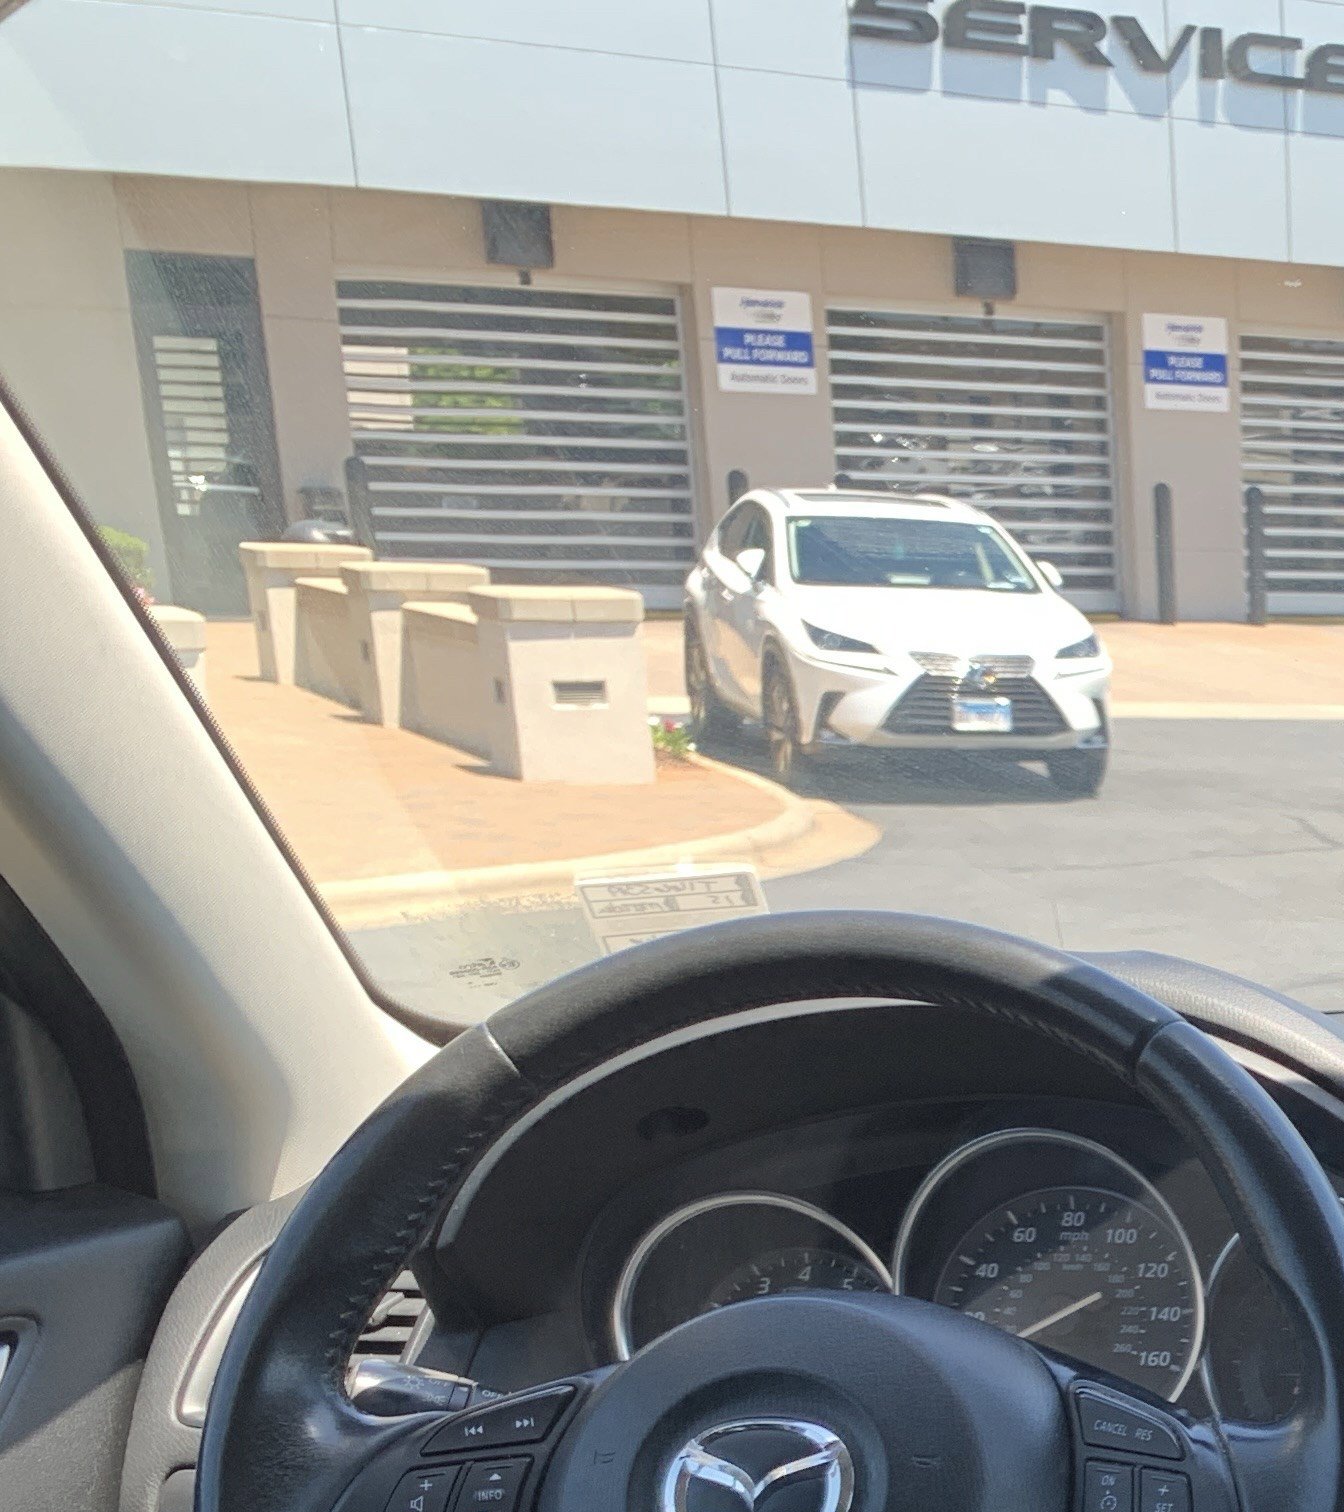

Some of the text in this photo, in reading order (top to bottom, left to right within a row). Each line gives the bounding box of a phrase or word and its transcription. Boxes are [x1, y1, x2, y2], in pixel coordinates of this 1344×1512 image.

[743, 333, 786, 347] PLEASE
[722, 347, 809, 362] PULL FORWARD
[1167, 356, 1204, 369] PLEASE
[1149, 368, 1225, 383] PULL FORWARD
[1061, 1211, 1085, 1227] 80
[1012, 1227, 1036, 1243] 60
[1059, 1231, 1090, 1242] mph
[1105, 1229, 1137, 1244] 100
[798, 1266, 812, 1282] 4
[975, 1263, 998, 1278] 40
[1136, 1262, 1168, 1278] 120
[757, 1277, 771, 1294] 3
[843, 1278, 854, 1291] 5
[1150, 1306, 1180, 1322] 140
[1138, 1350, 1170, 1367] 160
[1094, 1420, 1153, 1441] CANCEL RES
[1101, 1475, 1116, 1486] ON
[477, 1489, 503, 1500] INFO
